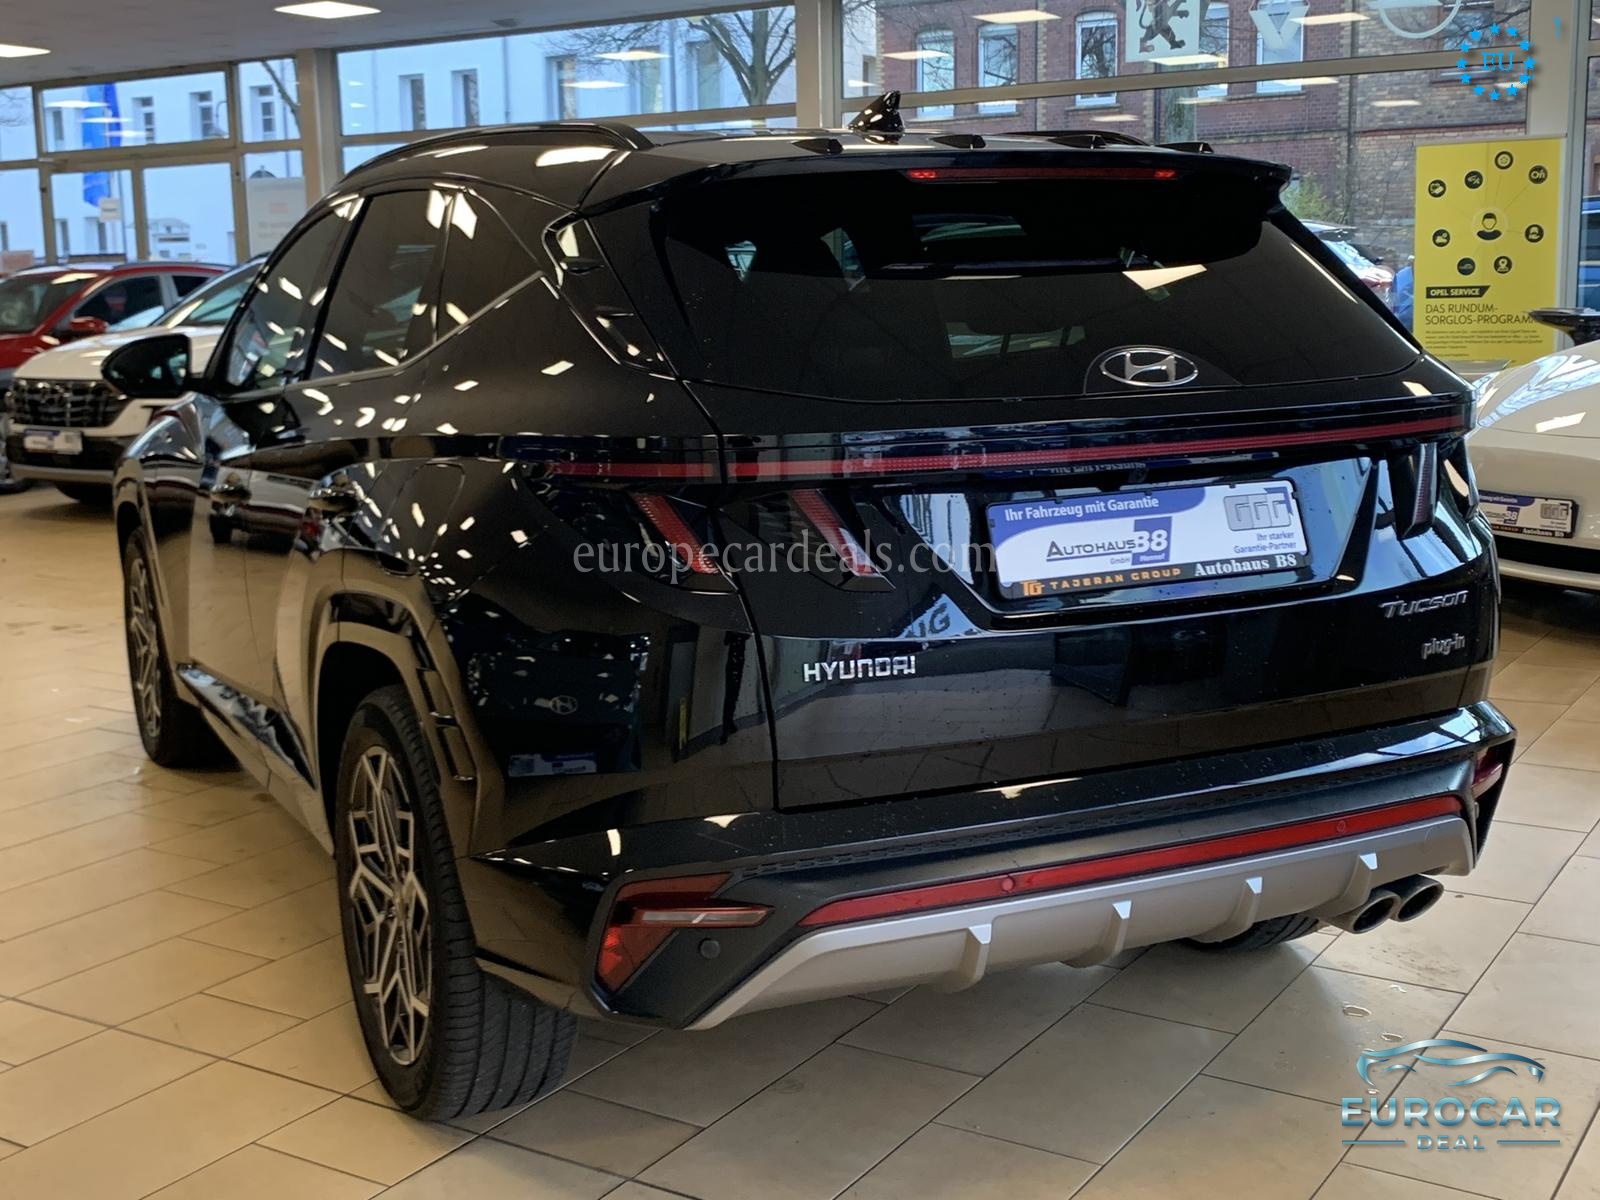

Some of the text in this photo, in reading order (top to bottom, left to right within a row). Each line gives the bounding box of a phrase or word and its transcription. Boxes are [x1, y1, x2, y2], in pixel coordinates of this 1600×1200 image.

[1430, 287, 1481, 297] OPEL SERVICE
[1425, 303, 1499, 314] DAS RUNDUM-
[1425, 314, 1538, 326] SORGLOS-PROGRAM
[1005, 496, 1160, 521] Ihr Fahrzeug mit Garantie
[1256, 530, 1295, 541] Ihr starker
[1050, 574, 1124, 590] TAJERAN
[1131, 567, 1182, 581] GROUP
[1194, 559, 1270, 577] Autohaus
[1275, 553, 1298, 569] B8
[1422, 632, 1466, 660] plug-in
[803, 655, 916, 683] HYUNDAI
